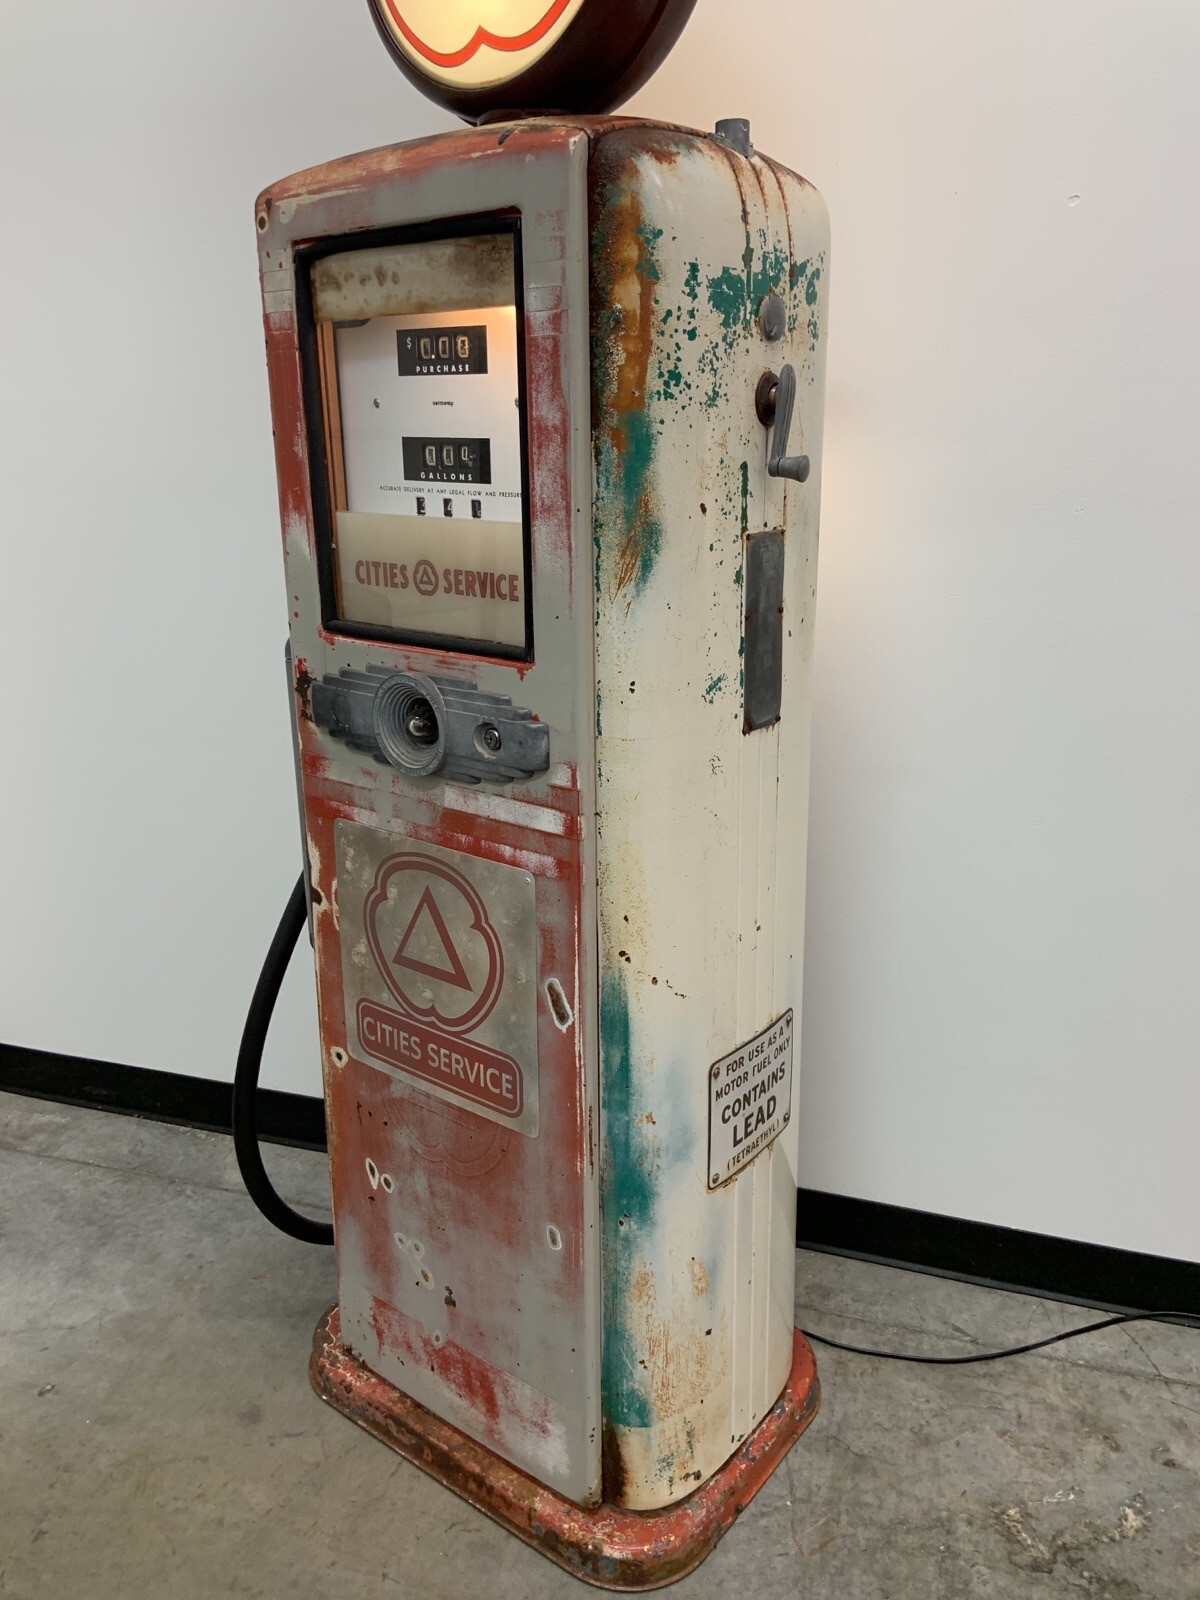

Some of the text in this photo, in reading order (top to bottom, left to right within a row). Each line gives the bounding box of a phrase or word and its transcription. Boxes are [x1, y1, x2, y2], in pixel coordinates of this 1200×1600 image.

[416, 364, 470, 373] PURCHASE
[403, 486, 425, 494] DELIVERY
[449, 489, 465, 497] LEGAL
[420, 471, 473, 482] GALLONS
[355, 559, 520, 602] CITIES SERVICE
[363, 1016, 515, 1100] CITIES SERVICE
[715, 1035, 790, 1102] MOTOR FUEL ONLY
[726, 1026, 784, 1077] FOR USE AS A
[721, 1061, 786, 1125] CONTAINS
[733, 1095, 777, 1148] LEAD
